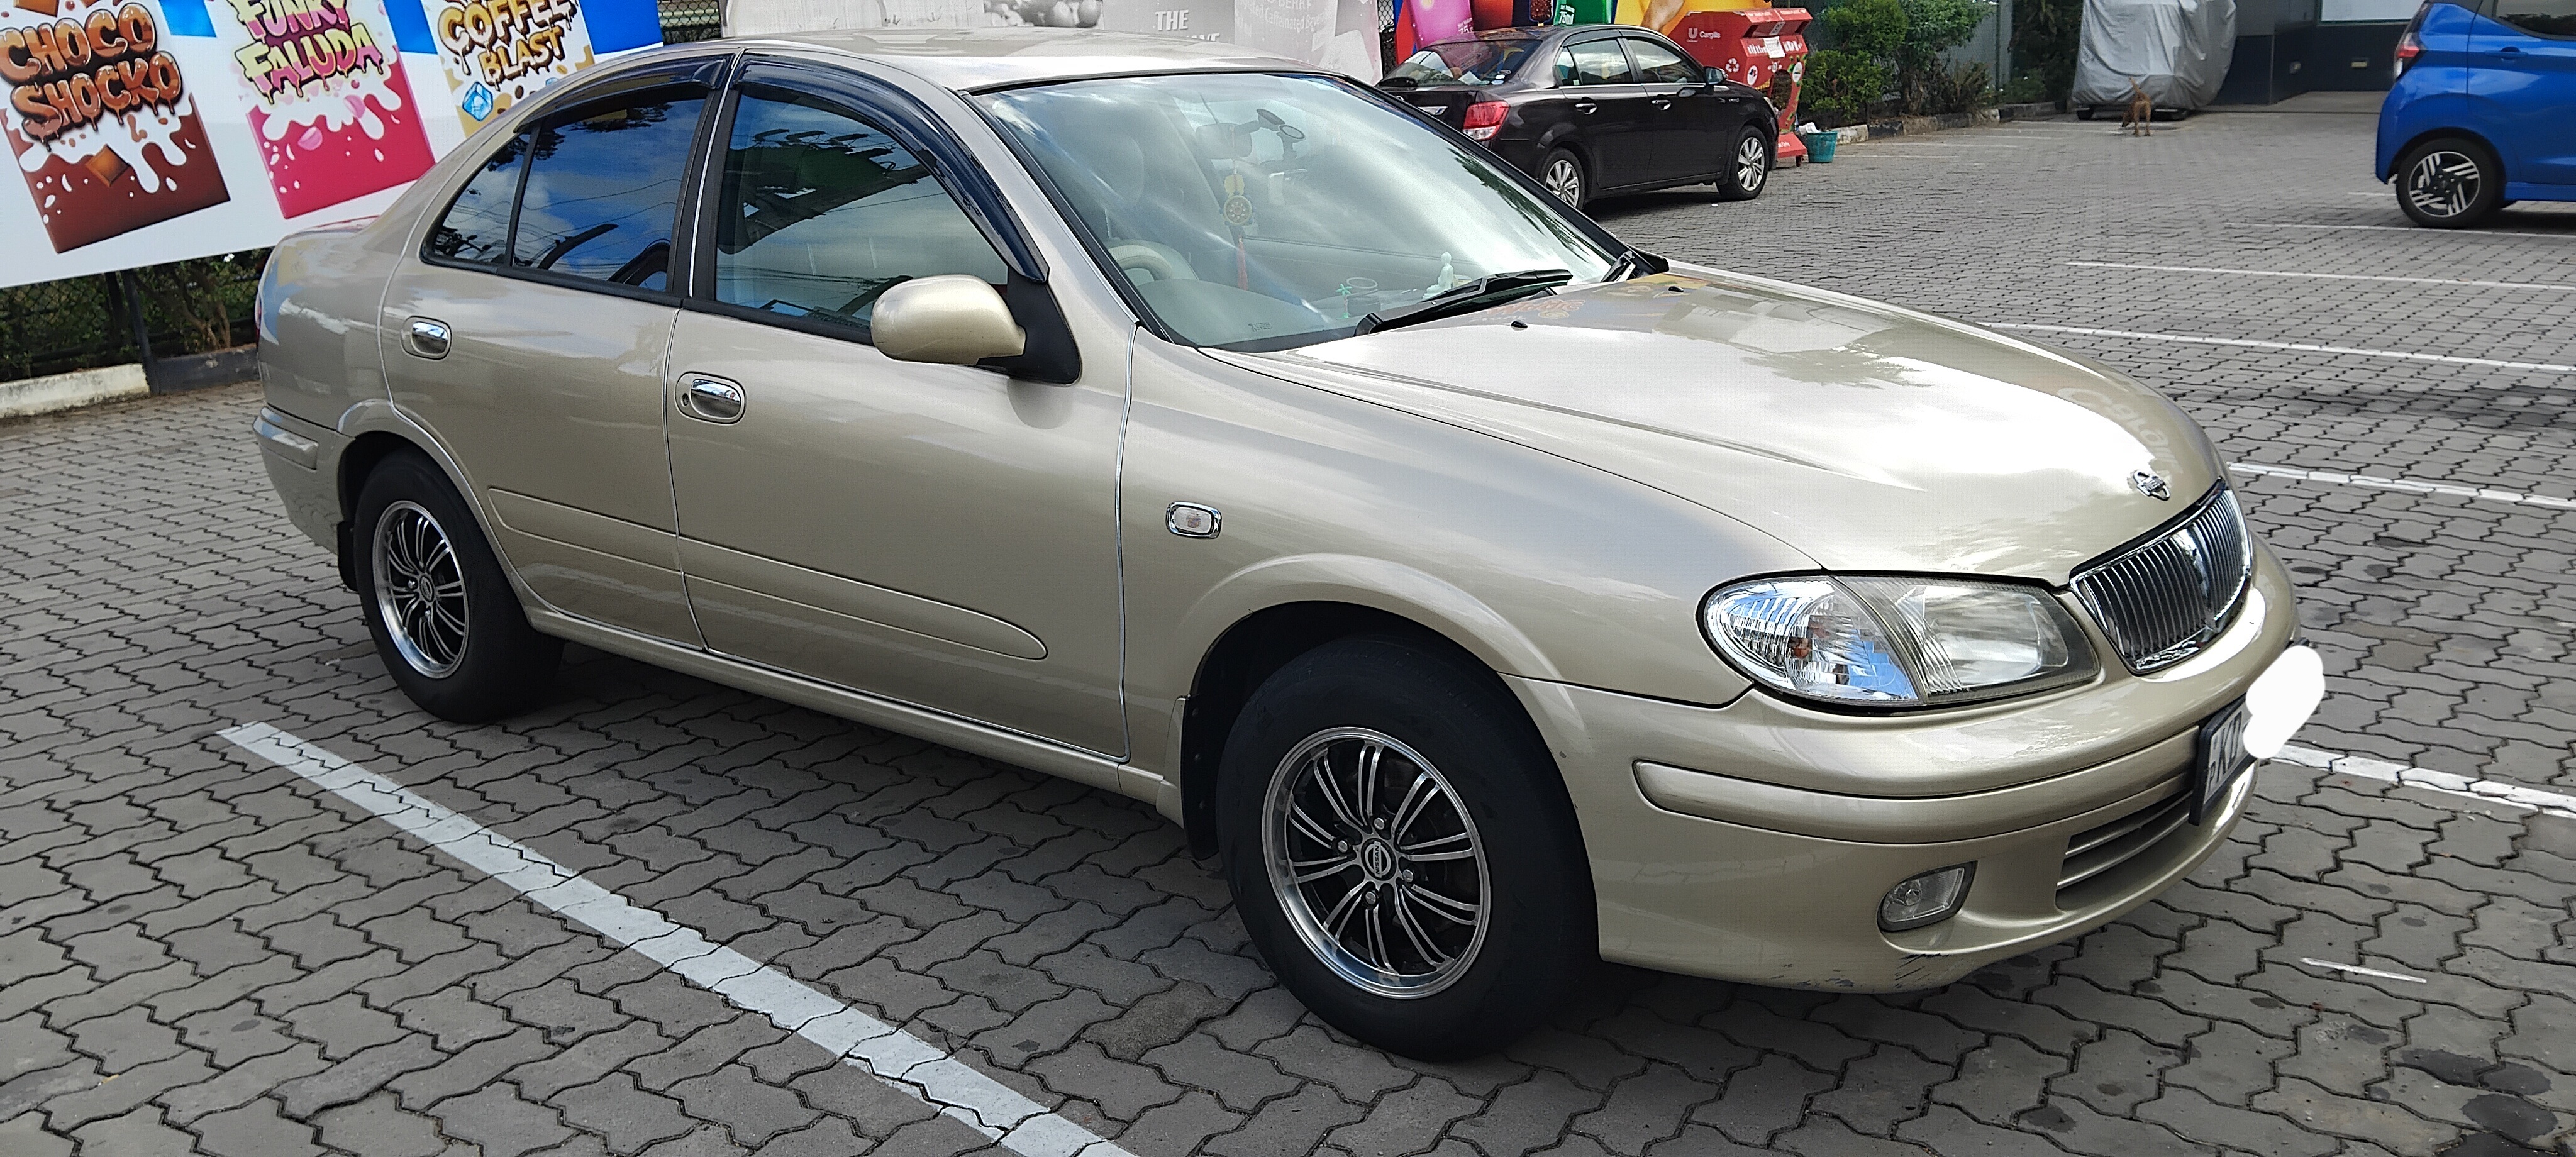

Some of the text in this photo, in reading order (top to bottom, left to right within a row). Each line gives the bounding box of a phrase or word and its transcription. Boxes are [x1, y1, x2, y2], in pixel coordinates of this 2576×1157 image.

[0, 2, 157, 86] CHOCO
[227, 0, 350, 42] FUNKY
[1155, 9, 1190, 31] THE
[235, 23, 383, 102] FALUDA
[478, 25, 565, 90] BLAST
[11, 51, 182, 143] SHOCKO
